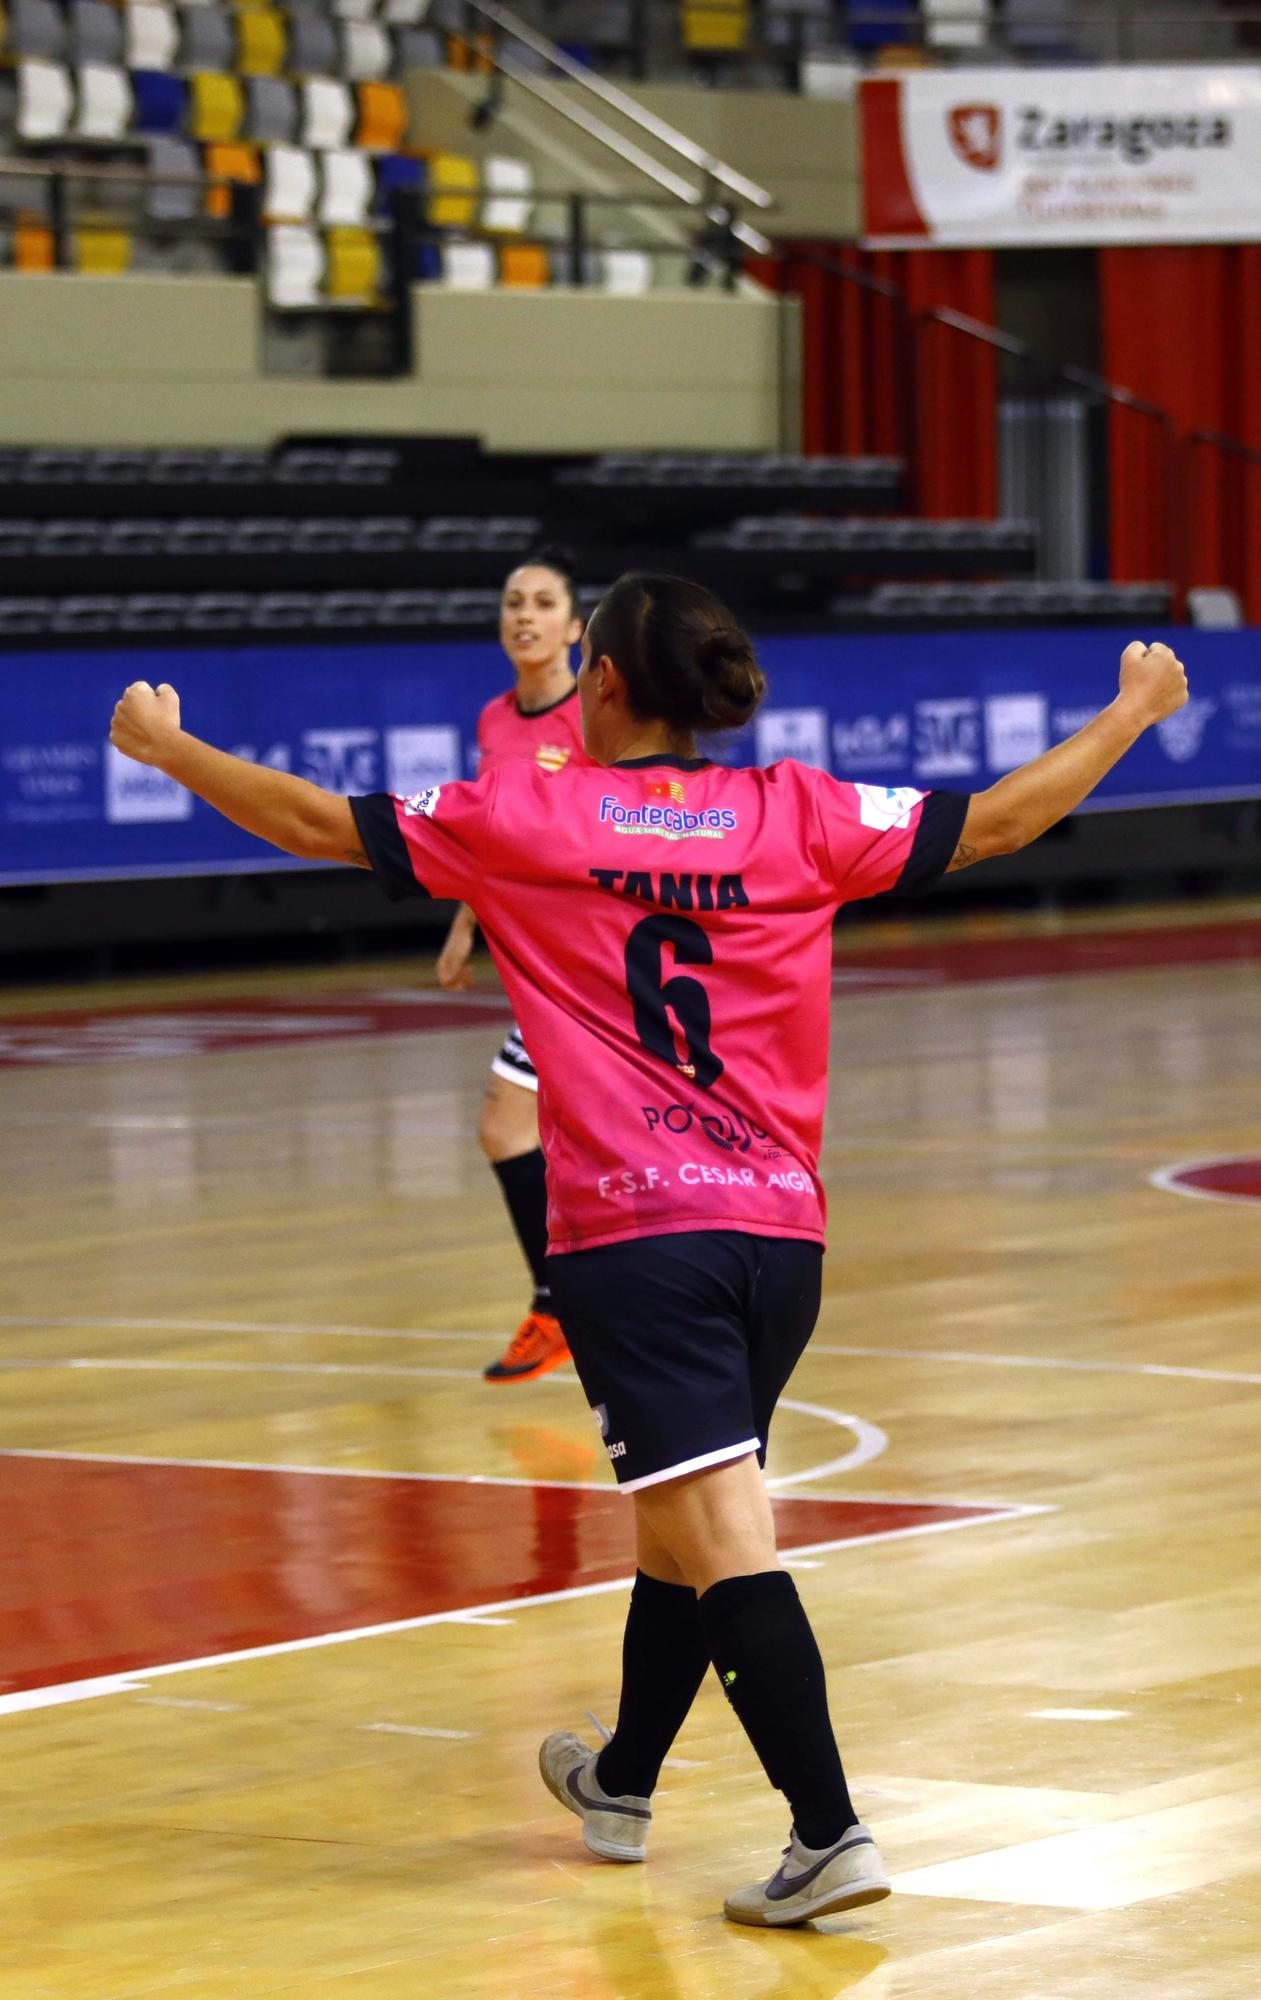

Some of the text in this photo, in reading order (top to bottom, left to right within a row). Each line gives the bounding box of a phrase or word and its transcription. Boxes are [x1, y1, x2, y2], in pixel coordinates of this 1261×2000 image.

[1017, 106, 1232, 165] Zaragoza
[589, 869, 749, 911] TANIA
[624, 914, 725, 1088] 6
[598, 1167, 670, 1197] F.S.F.
[679, 1163, 756, 1187] CESAR
